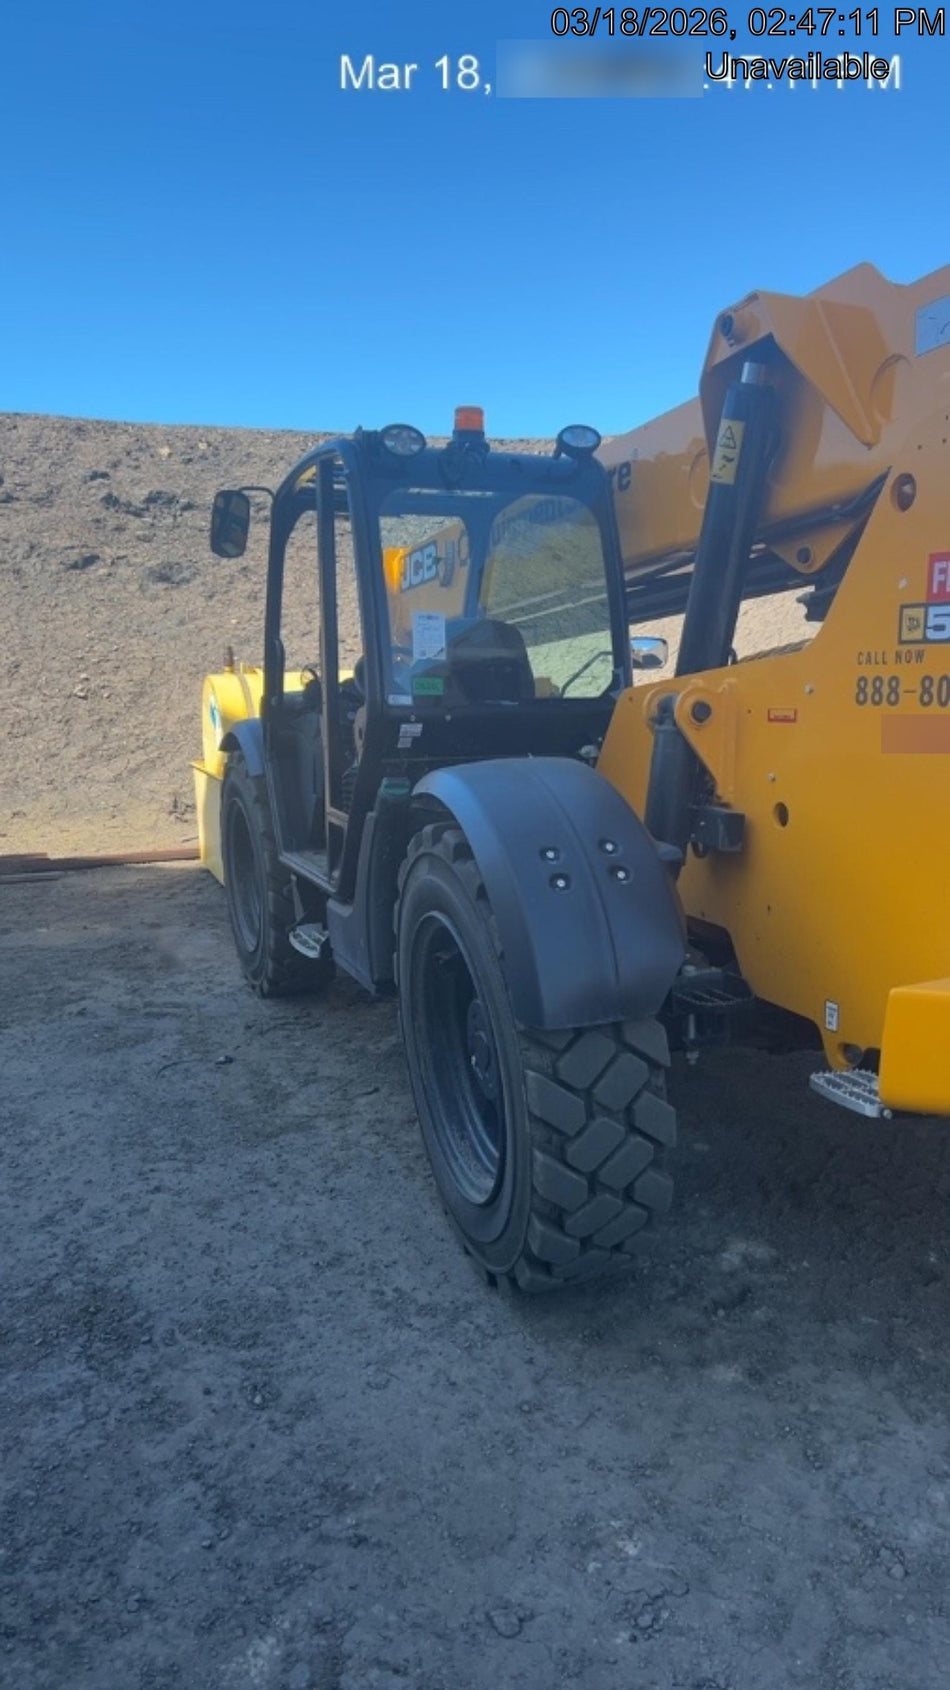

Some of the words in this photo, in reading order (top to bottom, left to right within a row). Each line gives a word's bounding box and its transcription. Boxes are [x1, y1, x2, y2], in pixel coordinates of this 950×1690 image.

[856, 651, 888, 666] CALL
[895, 649, 926, 665] NOW
[855, 674, 950, 708] 888-80
